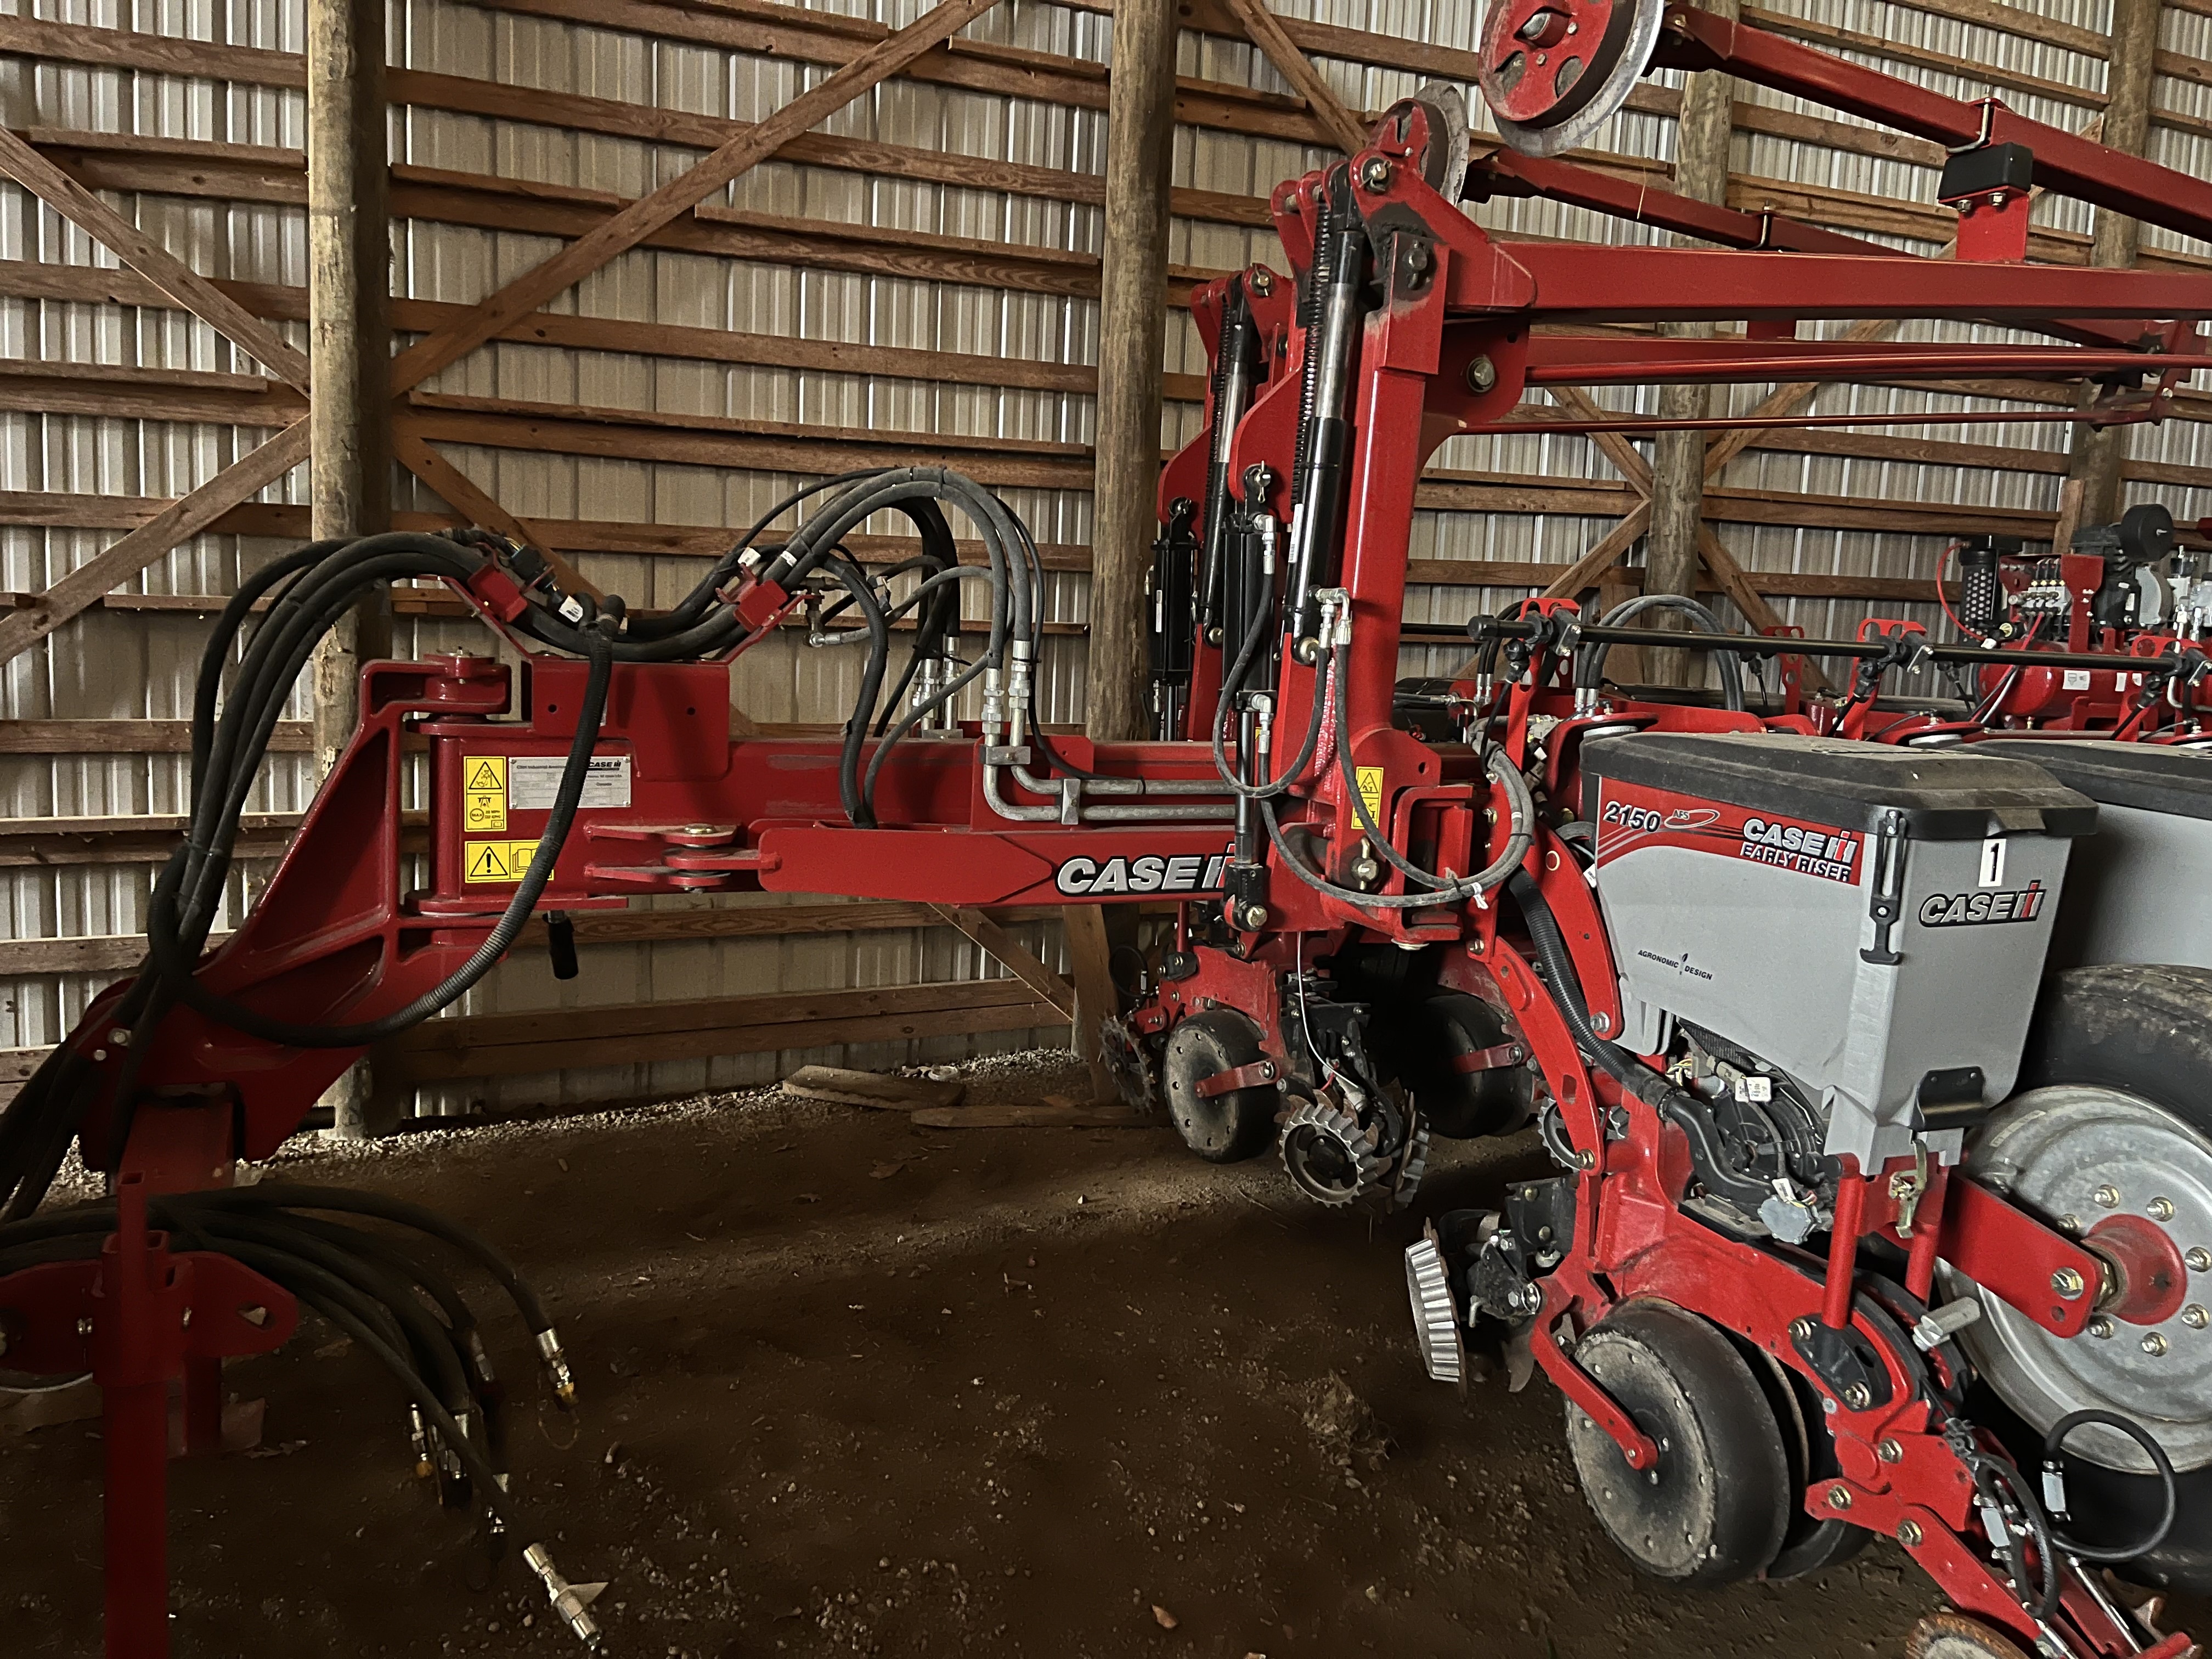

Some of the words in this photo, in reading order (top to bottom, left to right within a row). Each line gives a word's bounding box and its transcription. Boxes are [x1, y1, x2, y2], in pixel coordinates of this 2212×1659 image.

[1603, 801, 1661, 833] 2150
[1673, 809, 1690, 820] AFS
[1743, 819, 1826, 856] CASE
[1057, 856, 1201, 894] CASE
[1740, 842, 1797, 866] EARLY
[1796, 855, 1852, 882] RISER
[1990, 843, 2000, 882] 1
[1921, 894, 2015, 924] CASE
[1638, 950, 1679, 968] AGRONOMIC
[1684, 965, 1713, 980] DESIGN
